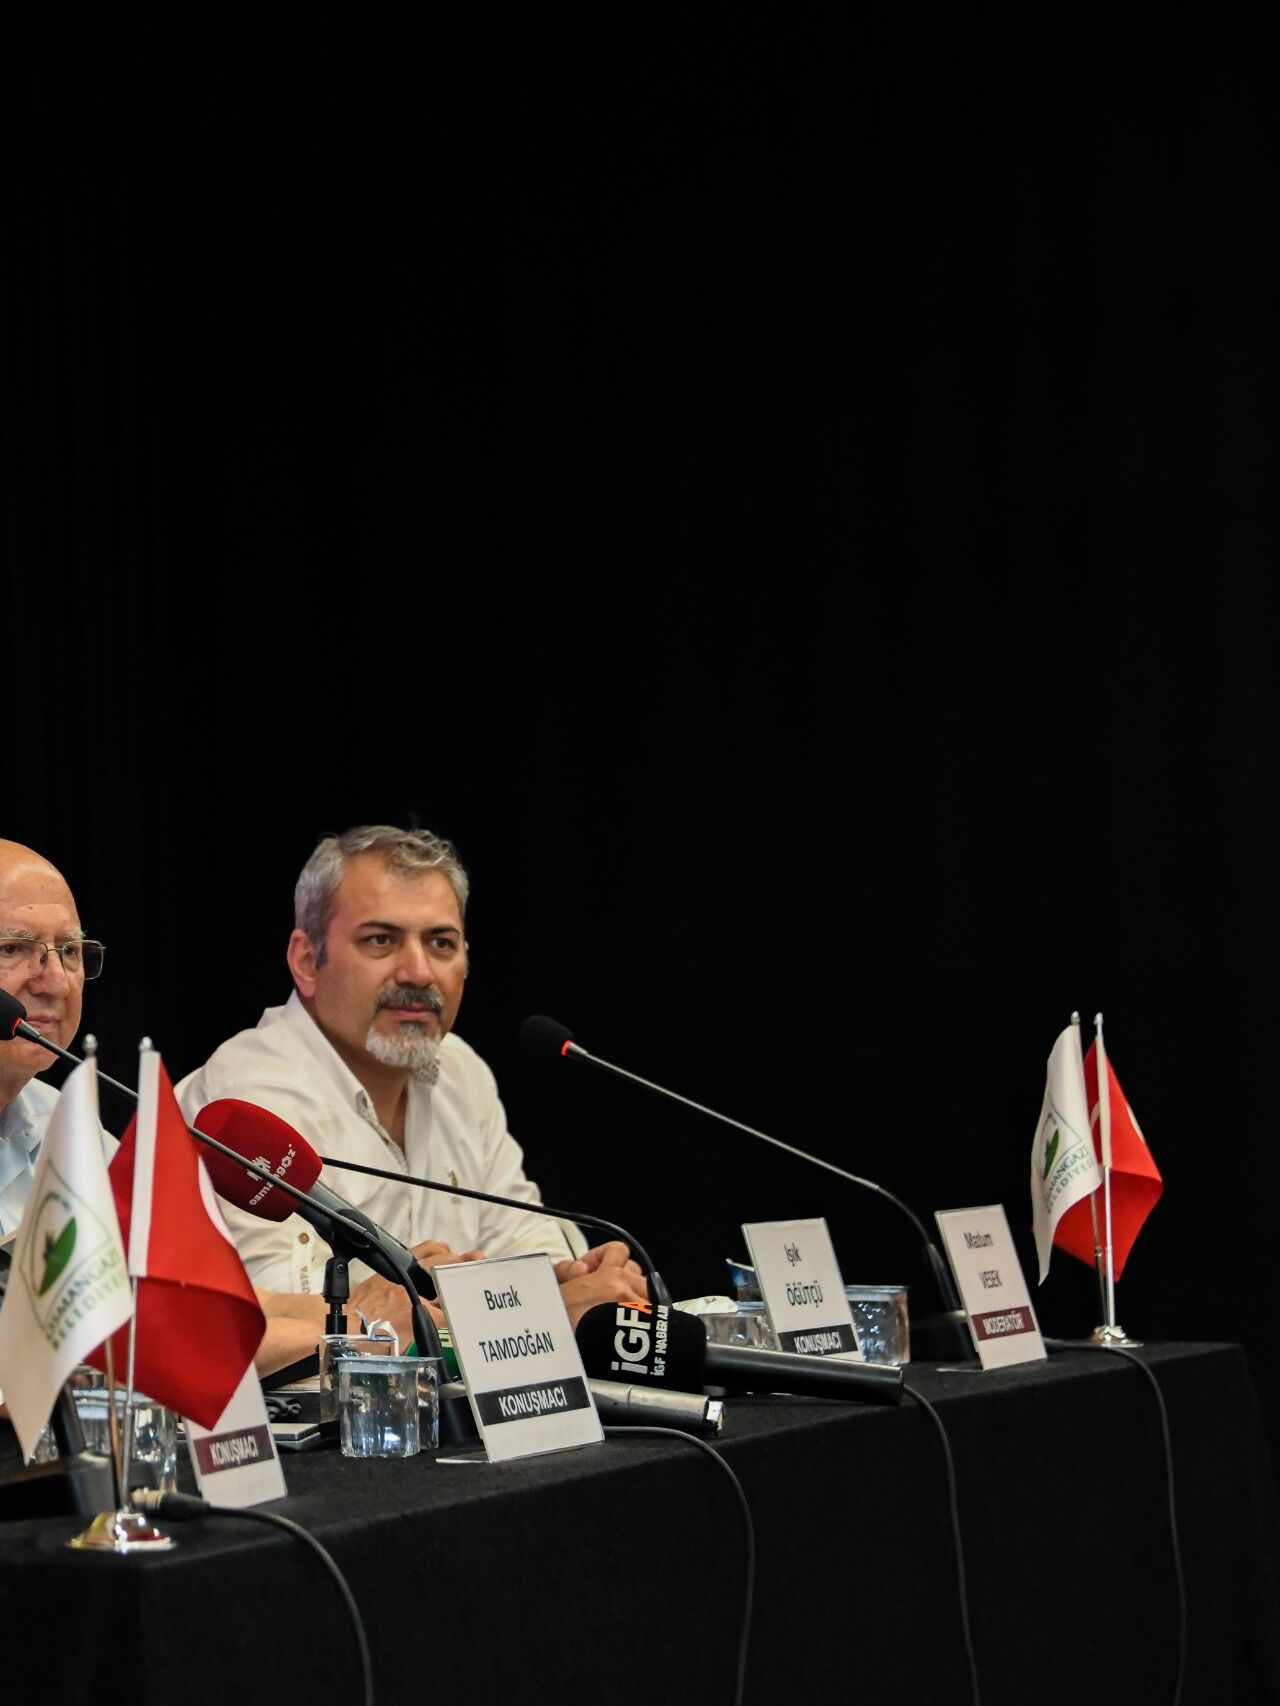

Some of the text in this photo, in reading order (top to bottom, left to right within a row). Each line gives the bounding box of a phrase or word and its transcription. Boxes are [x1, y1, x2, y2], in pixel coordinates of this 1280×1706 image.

[248, 1144, 296, 1206] osmagaz
[483, 1285, 522, 1311] Burak
[478, 1327, 556, 1363] TAMDOĞAN
[793, 1331, 843, 1355] KONUŞMACI
[498, 1386, 568, 1416] KONUŞMACI
[208, 1434, 259, 1466] KONUŞMACI
